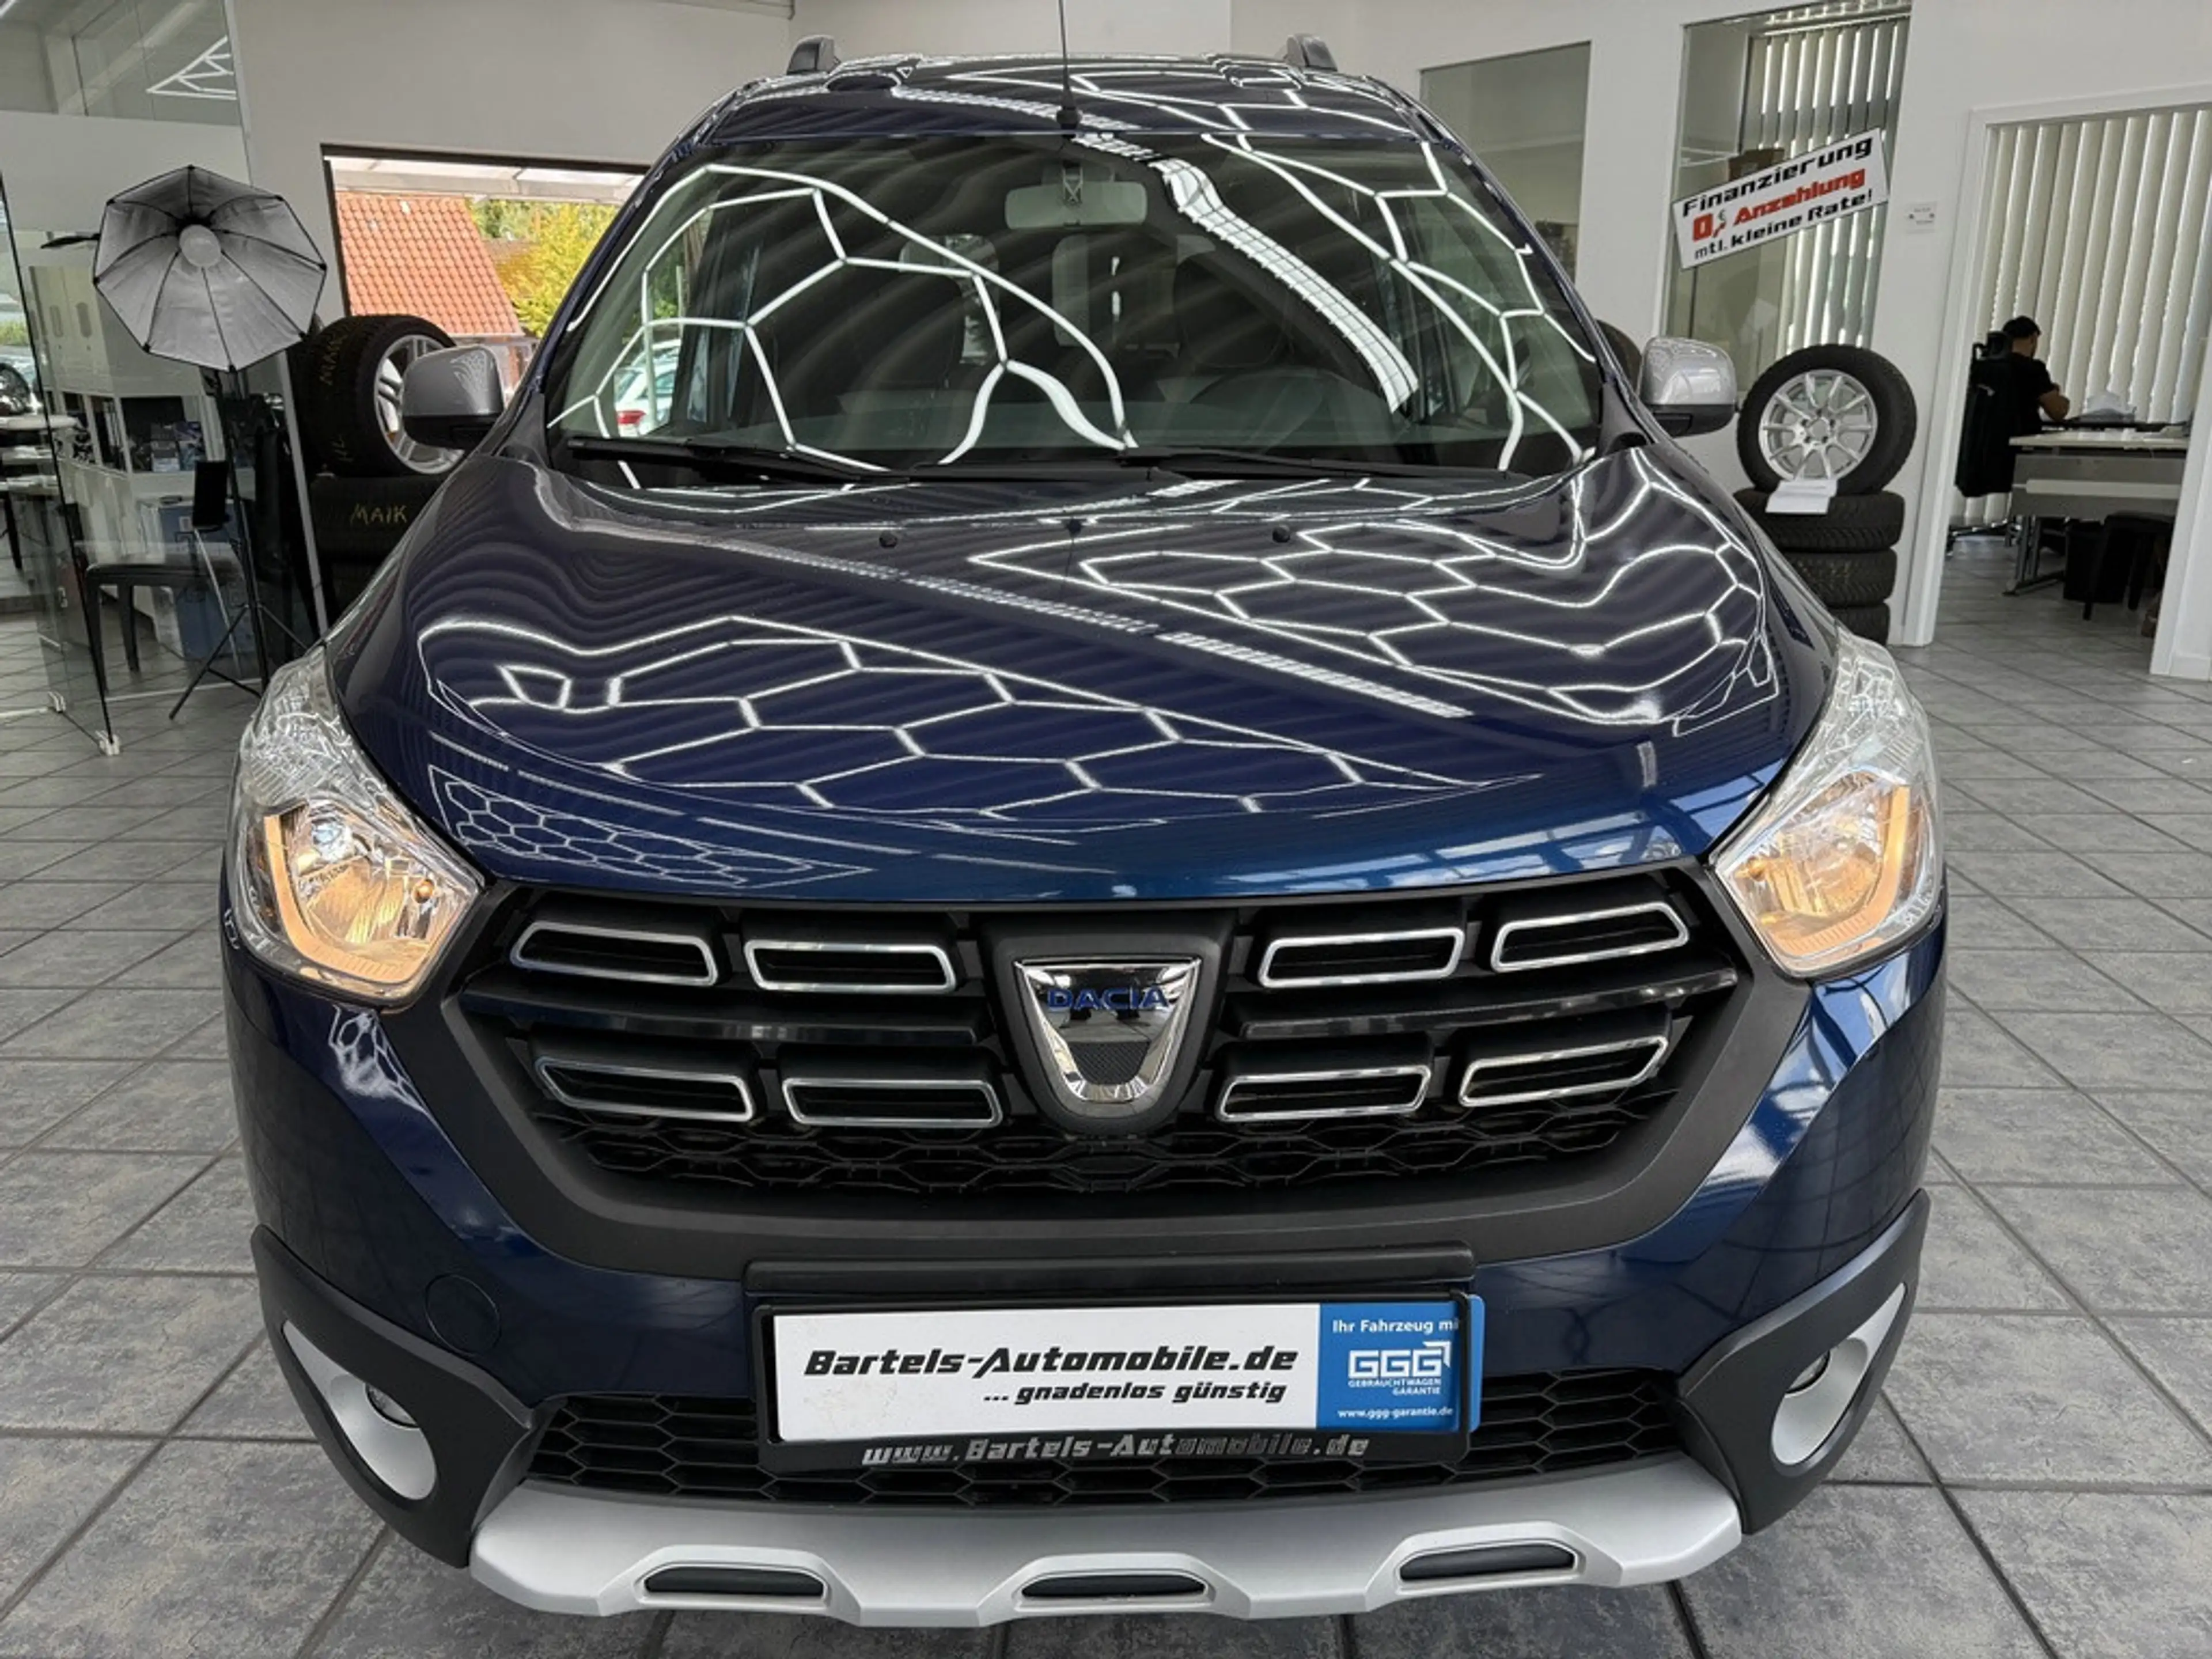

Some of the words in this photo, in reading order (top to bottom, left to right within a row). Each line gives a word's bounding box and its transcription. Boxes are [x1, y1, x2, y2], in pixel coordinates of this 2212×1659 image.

[1682, 137, 1873, 217] Finanzierung
[1733, 168, 1865, 225] Anzahlung
[1694, 239, 1728, 260] mtl.
[1730, 215, 1802, 248] kleine
[1808, 188, 1873, 222] Rate!
[349, 502, 408, 526] MAIK
[1047, 985, 1170, 1012] DACIA
[1332, 1319, 1355, 1334] Ihr
[1361, 1319, 1434, 1335] Fahrzeug
[804, 1346, 1299, 1379] Bartels-Automobile.de
[1348, 1349, 1442, 1378] GGG
[1014, 1382, 1165, 1405] gnadenlos
[1172, 1381, 1287, 1404] günstig
[1347, 1378, 1442, 1388] GEBRAUCHTWAGEN
[1392, 1387, 1441, 1396] GARANTIE
[1337, 1406, 1453, 1420] www.ggg-garantie.de
[862, 1433, 1370, 1465] www.Bartels-Automobile.de
